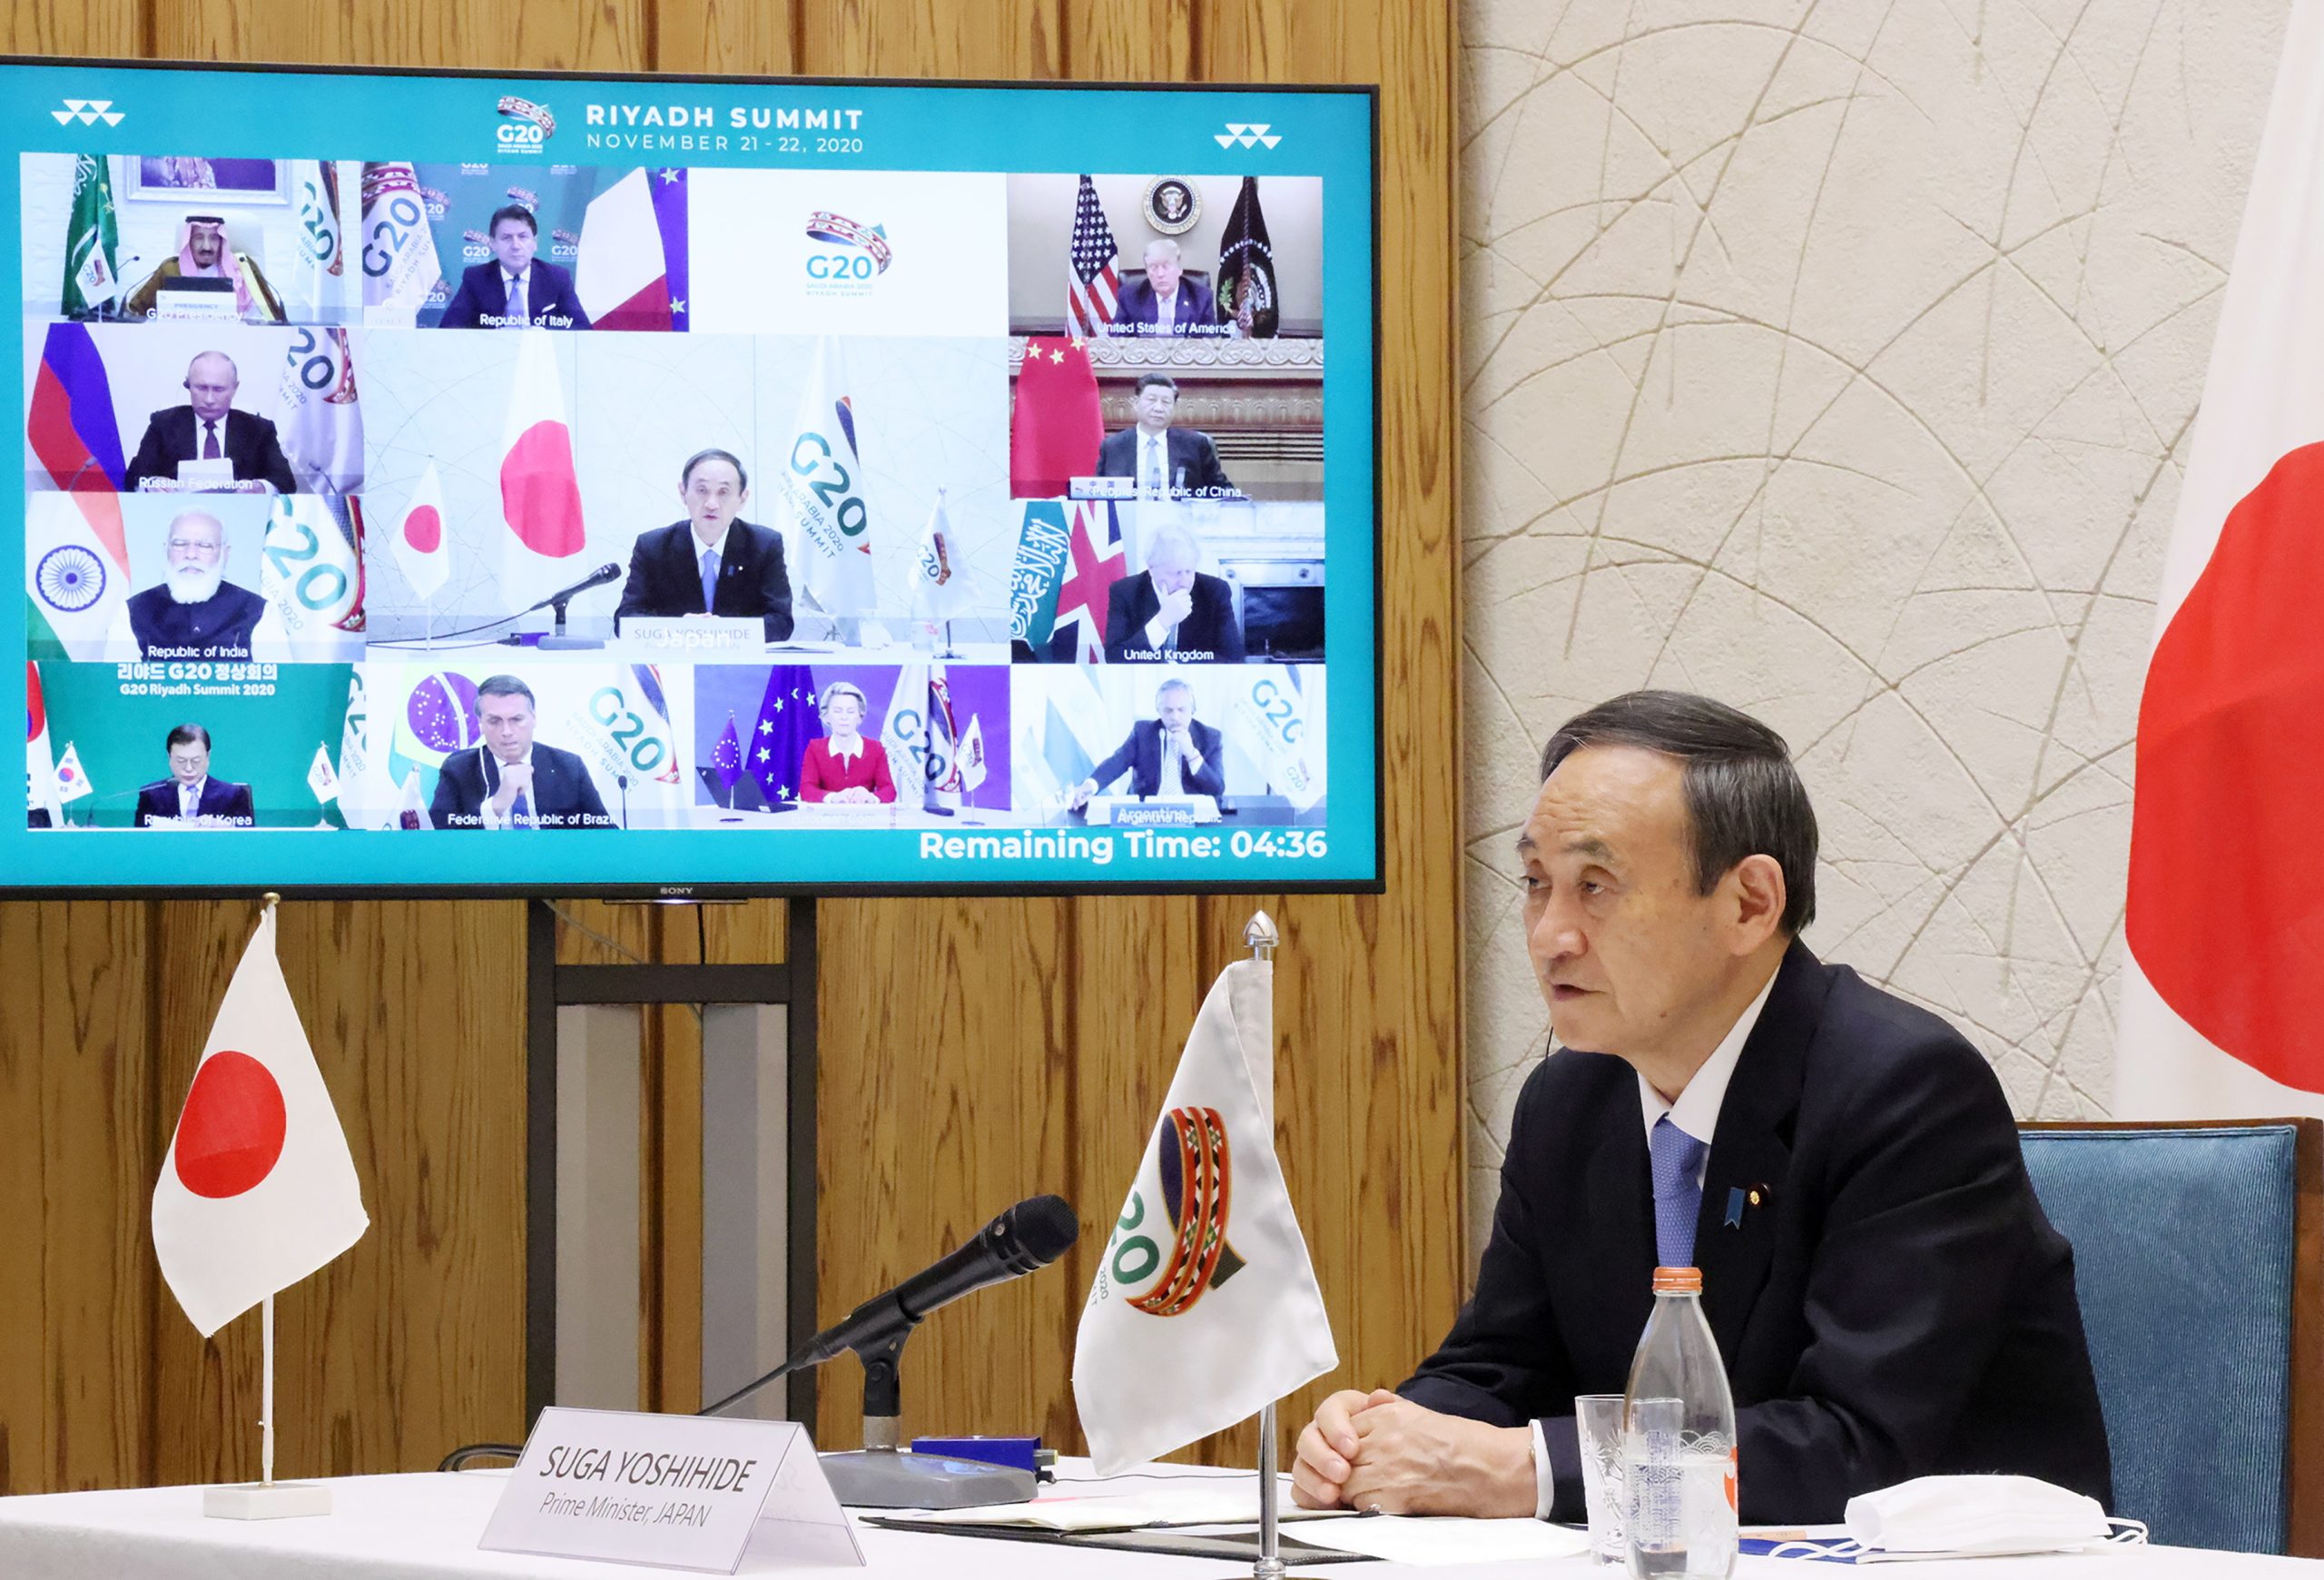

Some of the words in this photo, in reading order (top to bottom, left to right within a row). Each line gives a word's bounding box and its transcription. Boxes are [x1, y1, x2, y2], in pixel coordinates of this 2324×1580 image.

[586, 104, 714, 128] RIYADH
[730, 107, 863, 131] SUMMIT
[497, 124, 544, 143] G20
[586, 133, 728, 151] NOVEMBER
[740, 136, 758, 151] 21
[778, 137, 807, 153] 22,
[818, 137, 863, 153] 2020
[425, 204, 445, 214] 20
[363, 198, 420, 278] G20
[463, 246, 490, 257] G20
[551, 246, 577, 256] G20
[806, 255, 872, 280] G20
[427, 292, 446, 302] 20
[479, 314, 531, 327] Republic
[534, 314, 547, 325] of
[549, 314, 574, 328] Italy
[1098, 322, 1135, 333] United
[1137, 322, 1174, 334] States
[1175, 323, 1187, 334] of
[1188, 323, 1236, 335] America
[286, 327, 336, 390] 20
[138, 477, 185, 489] Russian
[188, 478, 253, 490] Federation
[791, 431, 868, 538] G20
[1195, 486, 1209, 497] of
[1209, 486, 1243, 497] China
[793, 511, 836, 559] SUMMIT
[822, 523, 844, 552] 2020
[276, 597, 304, 631] 2020
[148, 646, 201, 659] Republic
[203, 646, 218, 657] of
[220, 646, 249, 657] India
[1124, 649, 1162, 660] United
[1164, 649, 1215, 663] Kingdom
[117, 664, 165, 680] 리야드
[168, 664, 212, 680] G20
[214, 664, 279, 681] 정상회의
[120, 683, 148, 695] G20
[150, 683, 192, 697] Riyadh
[193, 683, 241, 696] Summit
[242, 685, 275, 696] 2020
[1251, 678, 1305, 745] G20
[589, 686, 665, 772] G20
[892, 708, 946, 783] G20
[1285, 765, 1305, 790] G20
[144, 814, 196, 826] Rblic
[216, 814, 252, 825] Korea
[448, 814, 510, 825] Federative
[513, 814, 565, 826] Republic
[567, 814, 581, 825] of
[583, 814, 616, 825] Brazil
[1175, 813, 1223, 825] Replic
[920, 830, 1114, 864] Remaining
[1124, 830, 1221, 858] Time:
[1230, 831, 1328, 858] 04:36
[1110, 1190, 1161, 1285] 20
[539, 1446, 612, 1481] SUGA
[615, 1451, 757, 1493] YOSHIHIDE
[539, 1492, 586, 1516] Prime
[589, 1496, 654, 1525] Minister,
[652, 1502, 713, 1528] JAPAN
